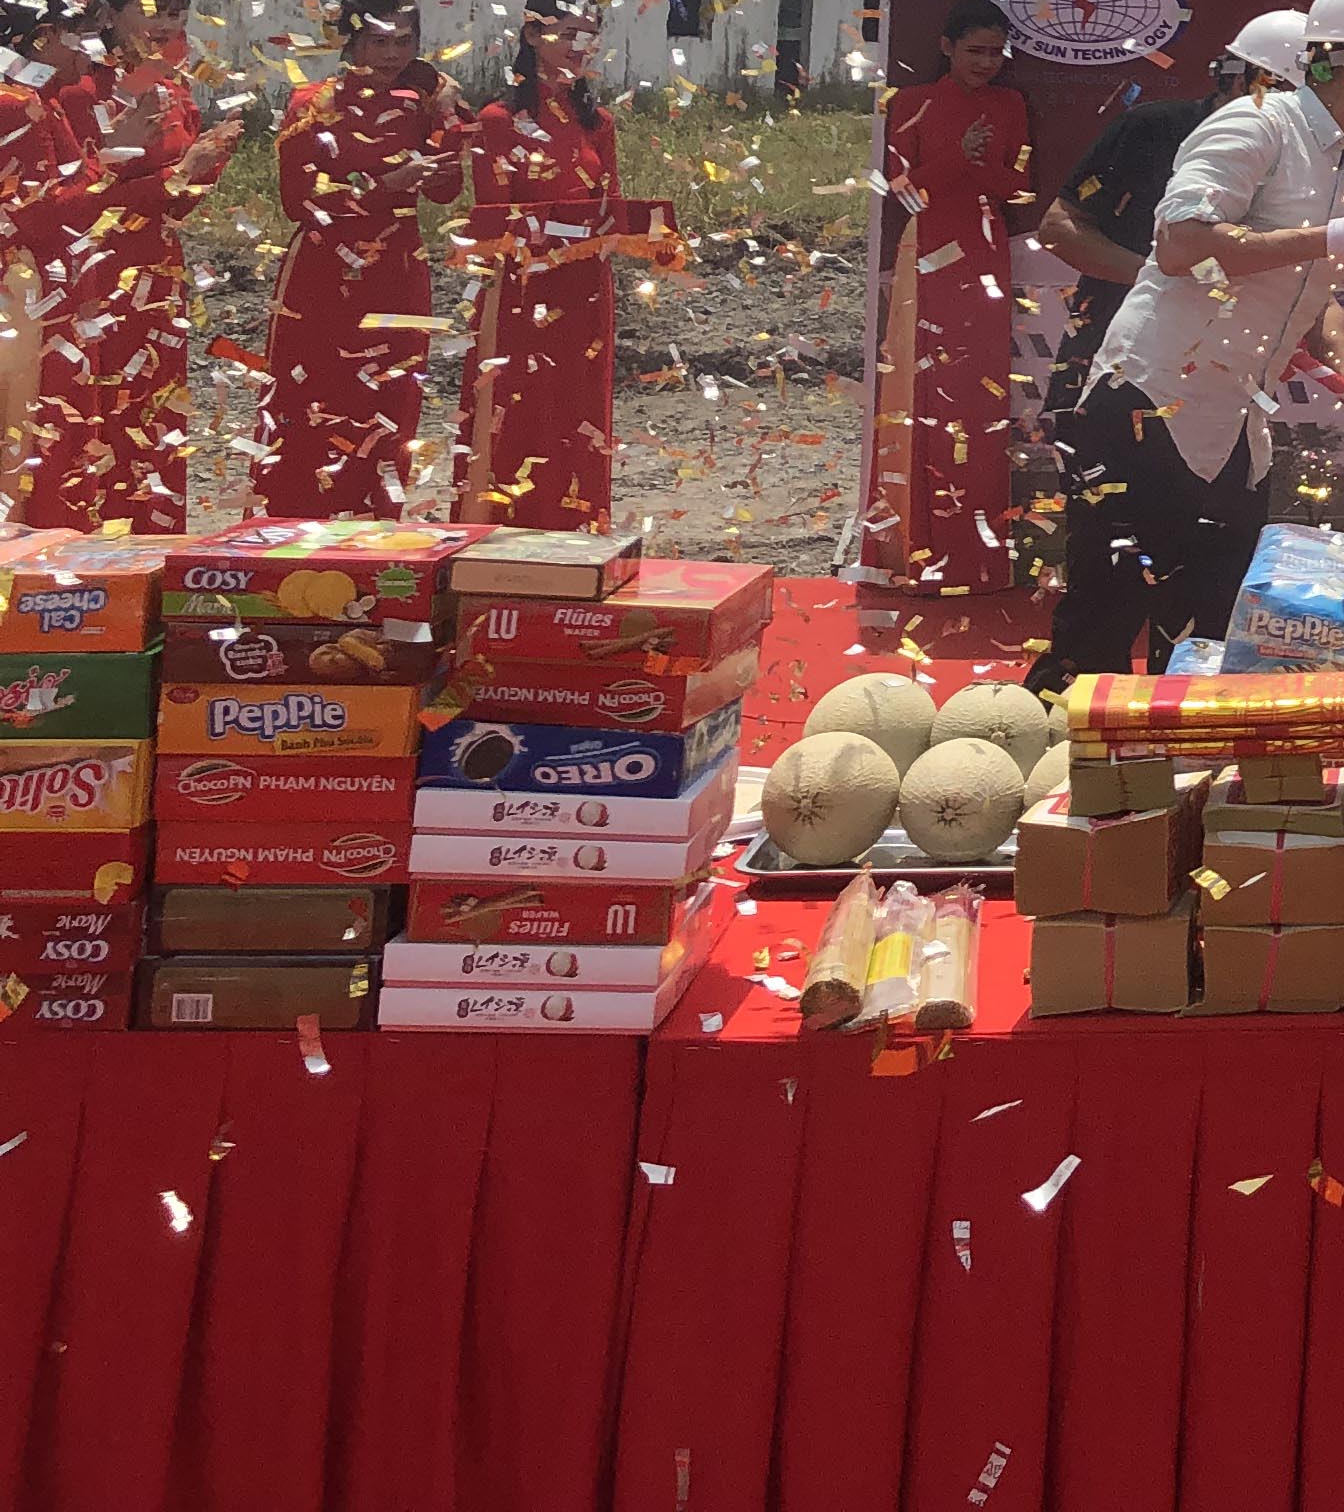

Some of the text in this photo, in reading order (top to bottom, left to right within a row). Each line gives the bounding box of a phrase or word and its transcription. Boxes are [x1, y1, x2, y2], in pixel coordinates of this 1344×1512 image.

[1008, 19, 1174, 61] ST SUN TECHNOGY
[184, 566, 254, 591] COSY
[18, 589, 108, 613] Cheese
[42, 610, 83, 632] Cal
[488, 608, 519, 640] LU
[553, 607, 614, 628] Flûtes
[473, 685, 535, 704] NGUYÊ
[538, 686, 590, 706] PHẠM
[210, 693, 347, 740] PepPie
[534, 753, 656, 786] OREO
[178, 772, 396, 795] ChocoPN PHẠM NGUYÊN
[175, 844, 396, 866] ChocoPN PHẠM NGUYÊN
[56, 913, 112, 936] Marie
[605, 904, 636, 935] LU
[40, 939, 110, 962] COSY
[51, 972, 109, 996] Marie
[34, 999, 105, 1022] COSY
